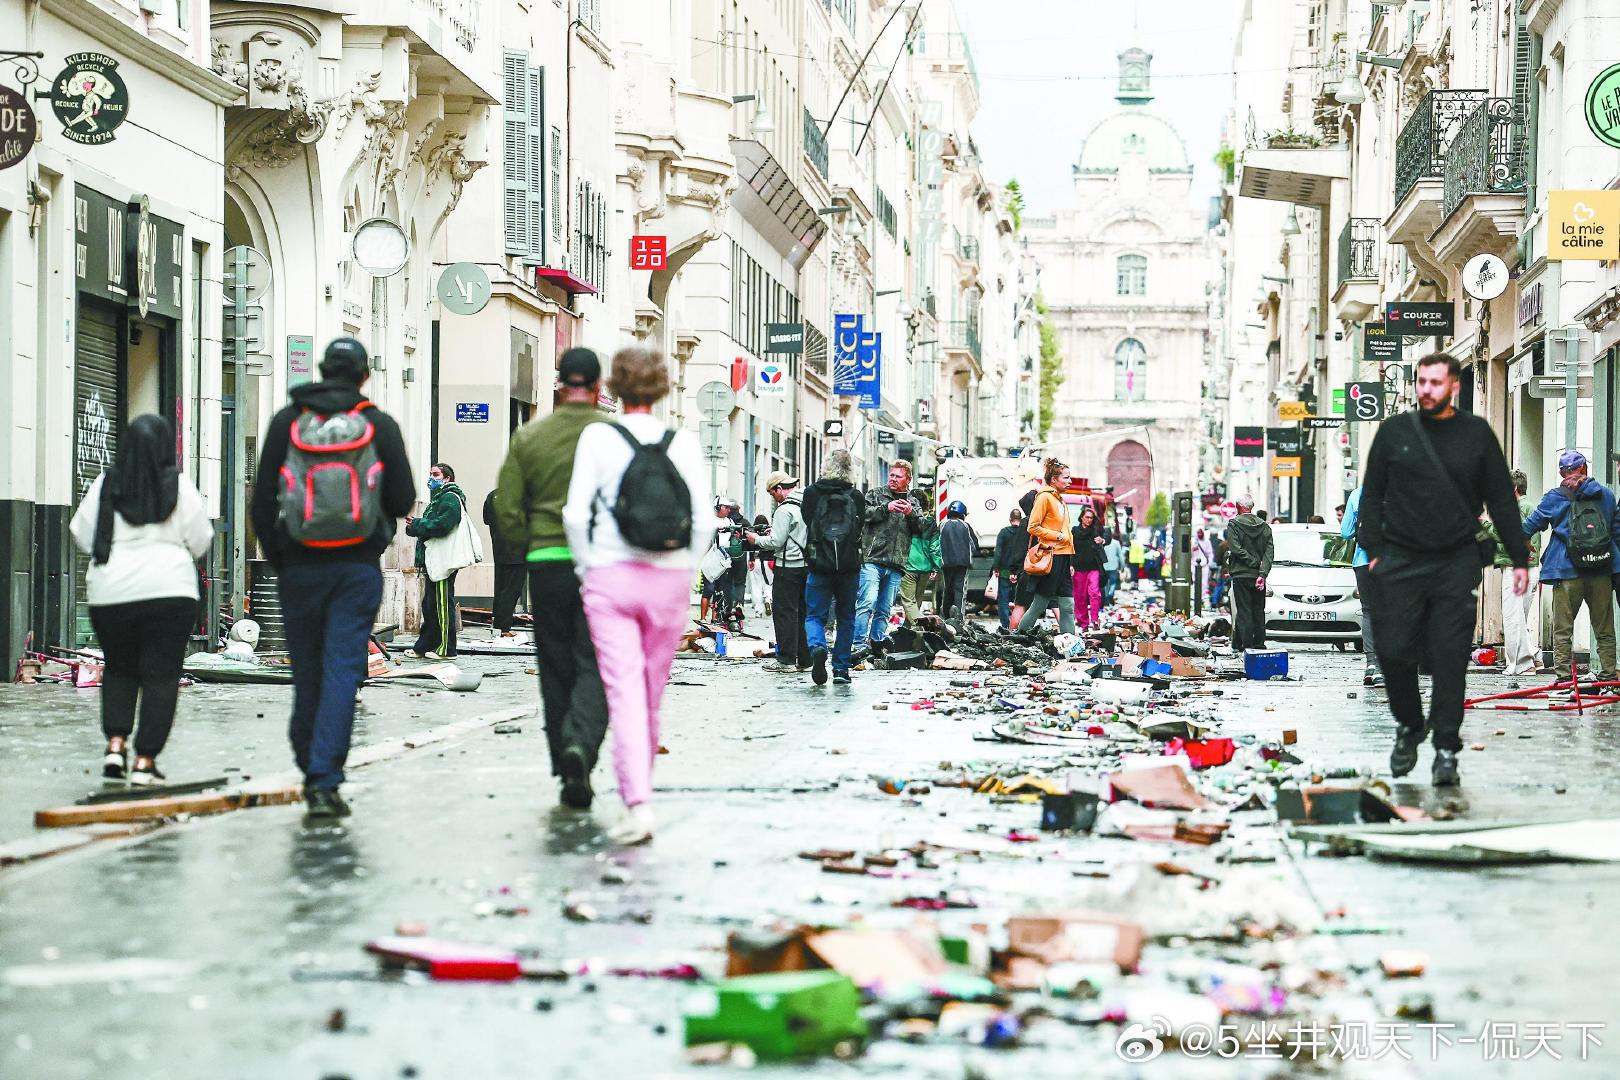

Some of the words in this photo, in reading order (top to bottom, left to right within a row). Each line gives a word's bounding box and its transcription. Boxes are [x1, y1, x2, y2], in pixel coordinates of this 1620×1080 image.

[66, 53, 88, 65] KILO
[89, 53, 115, 67] SHOP
[76, 63, 105, 73] RECYCLE
[1601, 95, 1613, 111] LE
[1604, 108, 1620, 129] VA
[64, 128, 91, 143] SINCE
[92, 131, 112, 143] 1974
[1561, 222, 1575, 235] la
[1579, 222, 1605, 235] mie
[1561, 236, 1604, 248] câline
[1403, 312, 1442, 320] COURIR
[770, 333, 802, 344] BASIC-FIT
[840, 314, 857, 367] LCL
[861, 332, 876, 382] LCL
